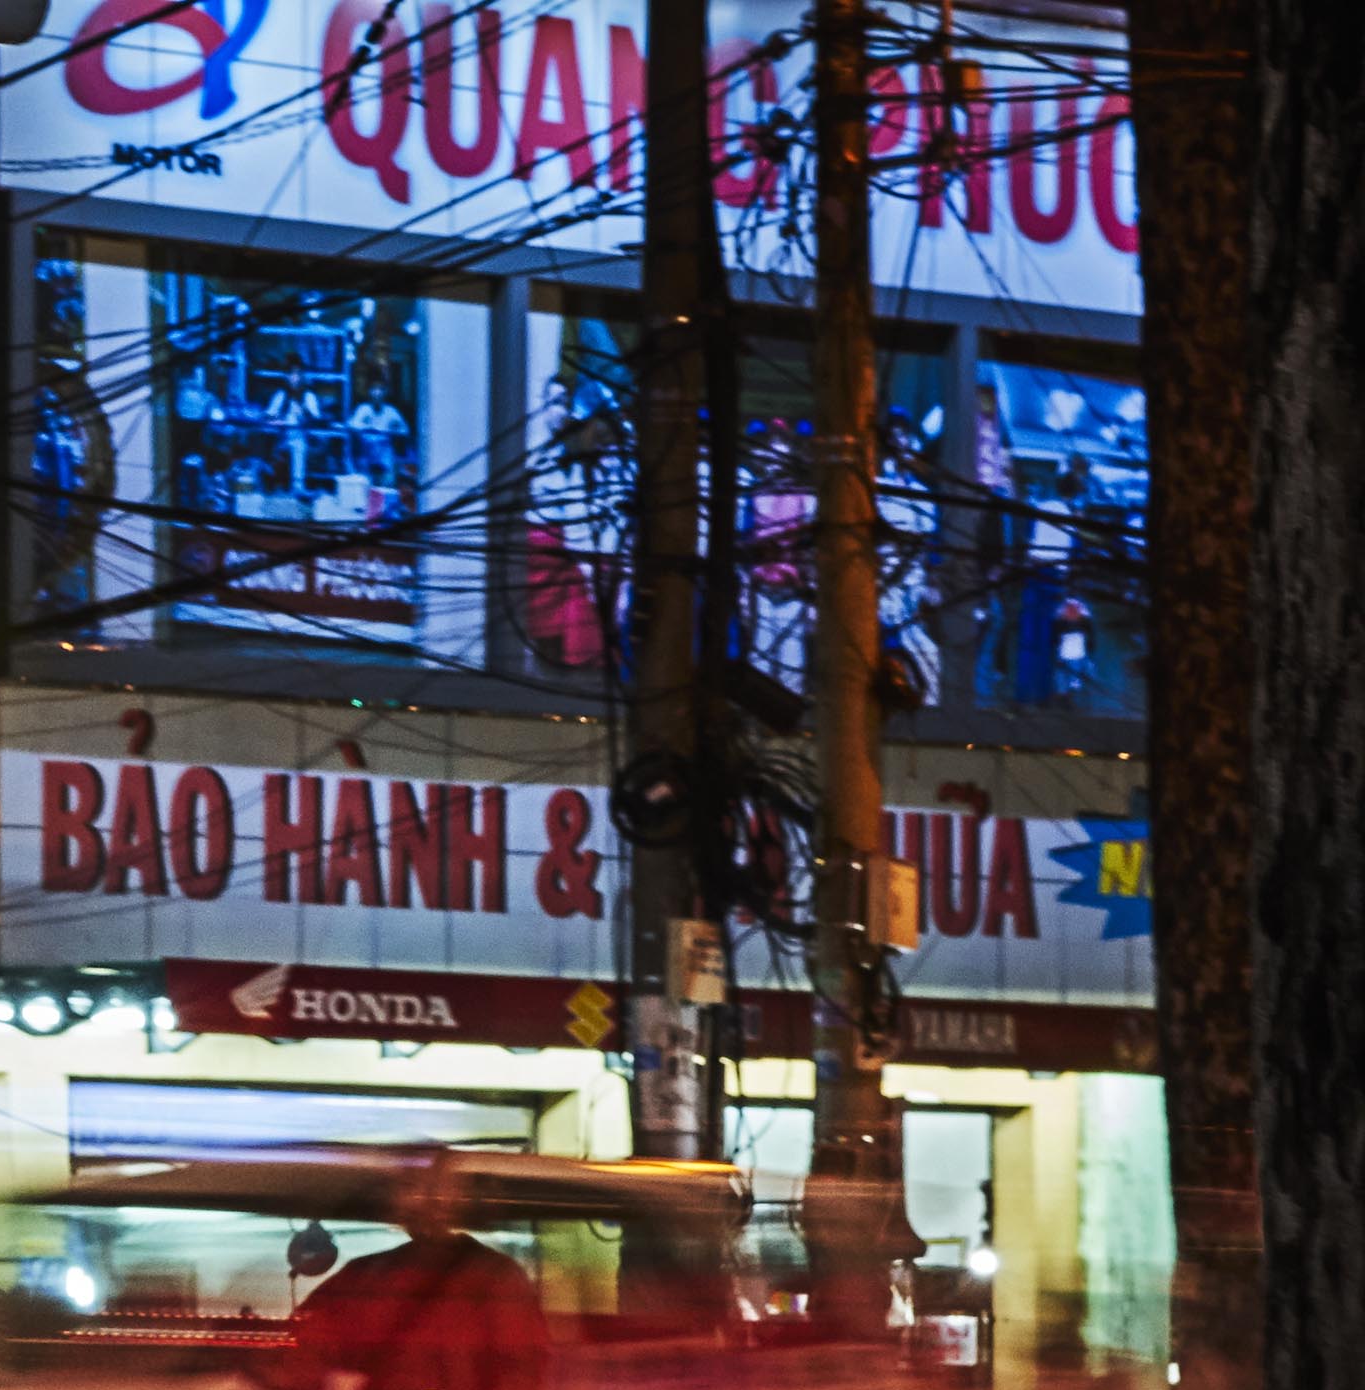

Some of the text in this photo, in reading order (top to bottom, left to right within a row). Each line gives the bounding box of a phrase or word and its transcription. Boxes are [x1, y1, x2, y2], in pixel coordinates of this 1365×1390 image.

[112, 141, 223, 178] MOTOR
[41, 708, 235, 901] BẢO
[264, 739, 509, 914] HÀNH
[535, 788, 604, 920] &
[291, 988, 459, 1030] HONDA
